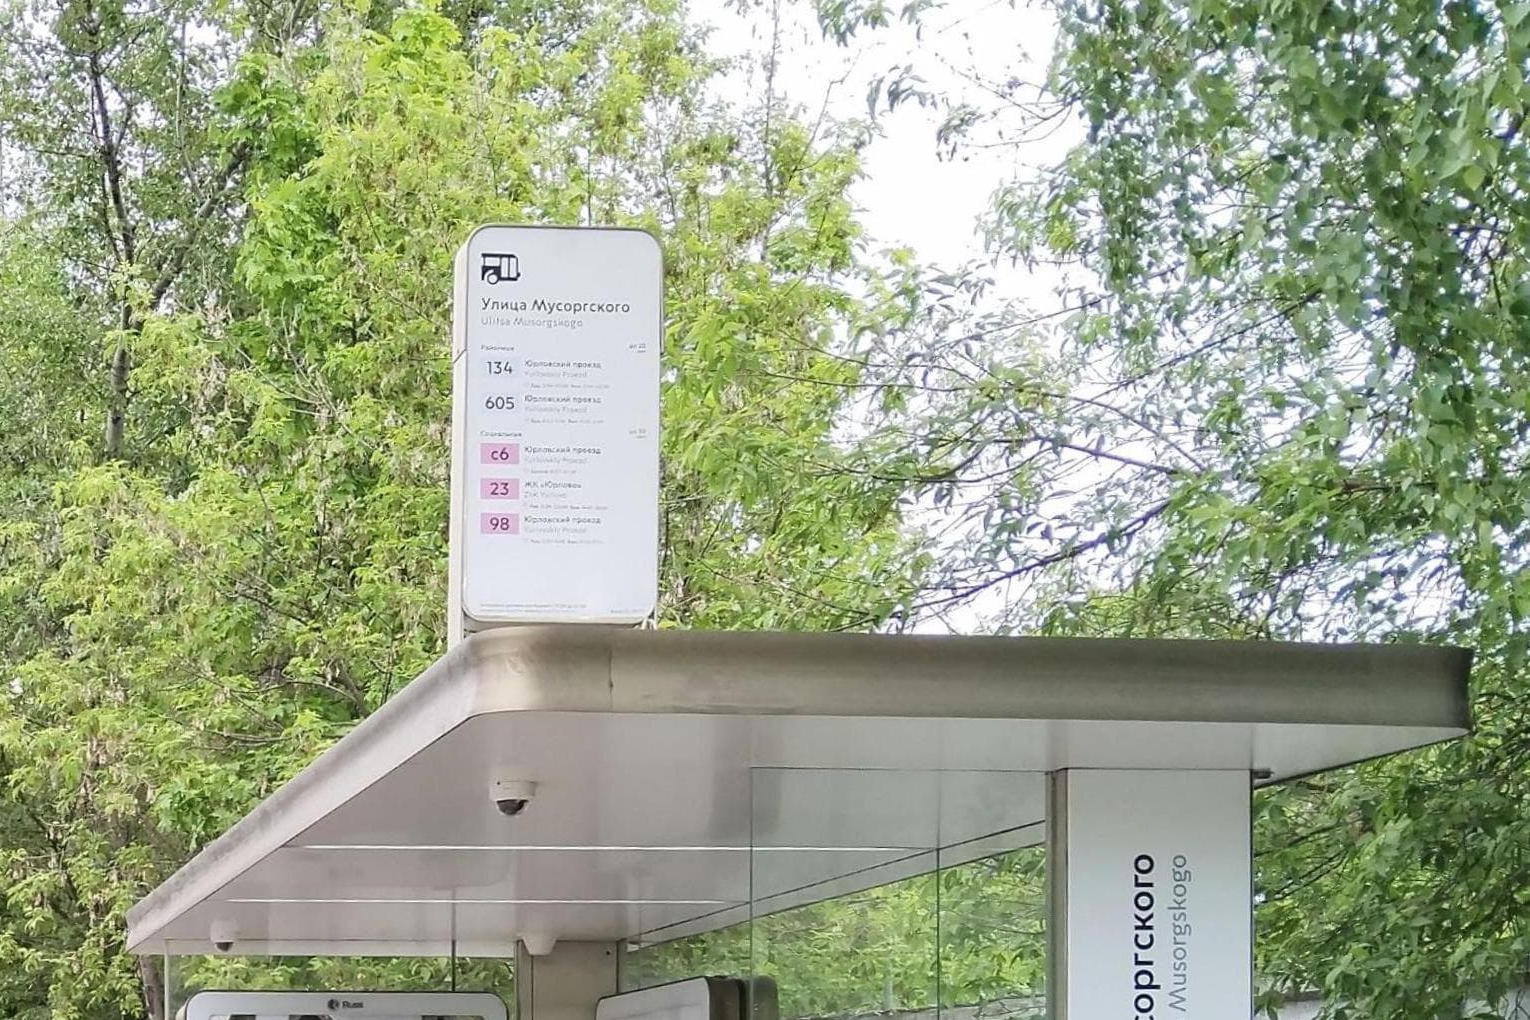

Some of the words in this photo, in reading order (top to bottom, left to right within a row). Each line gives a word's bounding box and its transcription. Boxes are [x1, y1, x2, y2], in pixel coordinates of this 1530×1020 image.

[481, 297, 527, 312] Улица
[531, 299, 630, 315] Мусоргского
[481, 317, 511, 327] Ulitsa
[513, 317, 583, 329] Musorgskogo
[486, 360, 513, 375] 134
[485, 396, 515, 411] 605
[489, 482, 510, 496] 23
[489, 517, 511, 531] 98
[1167, 854, 1192, 1013] Musorgskogo
